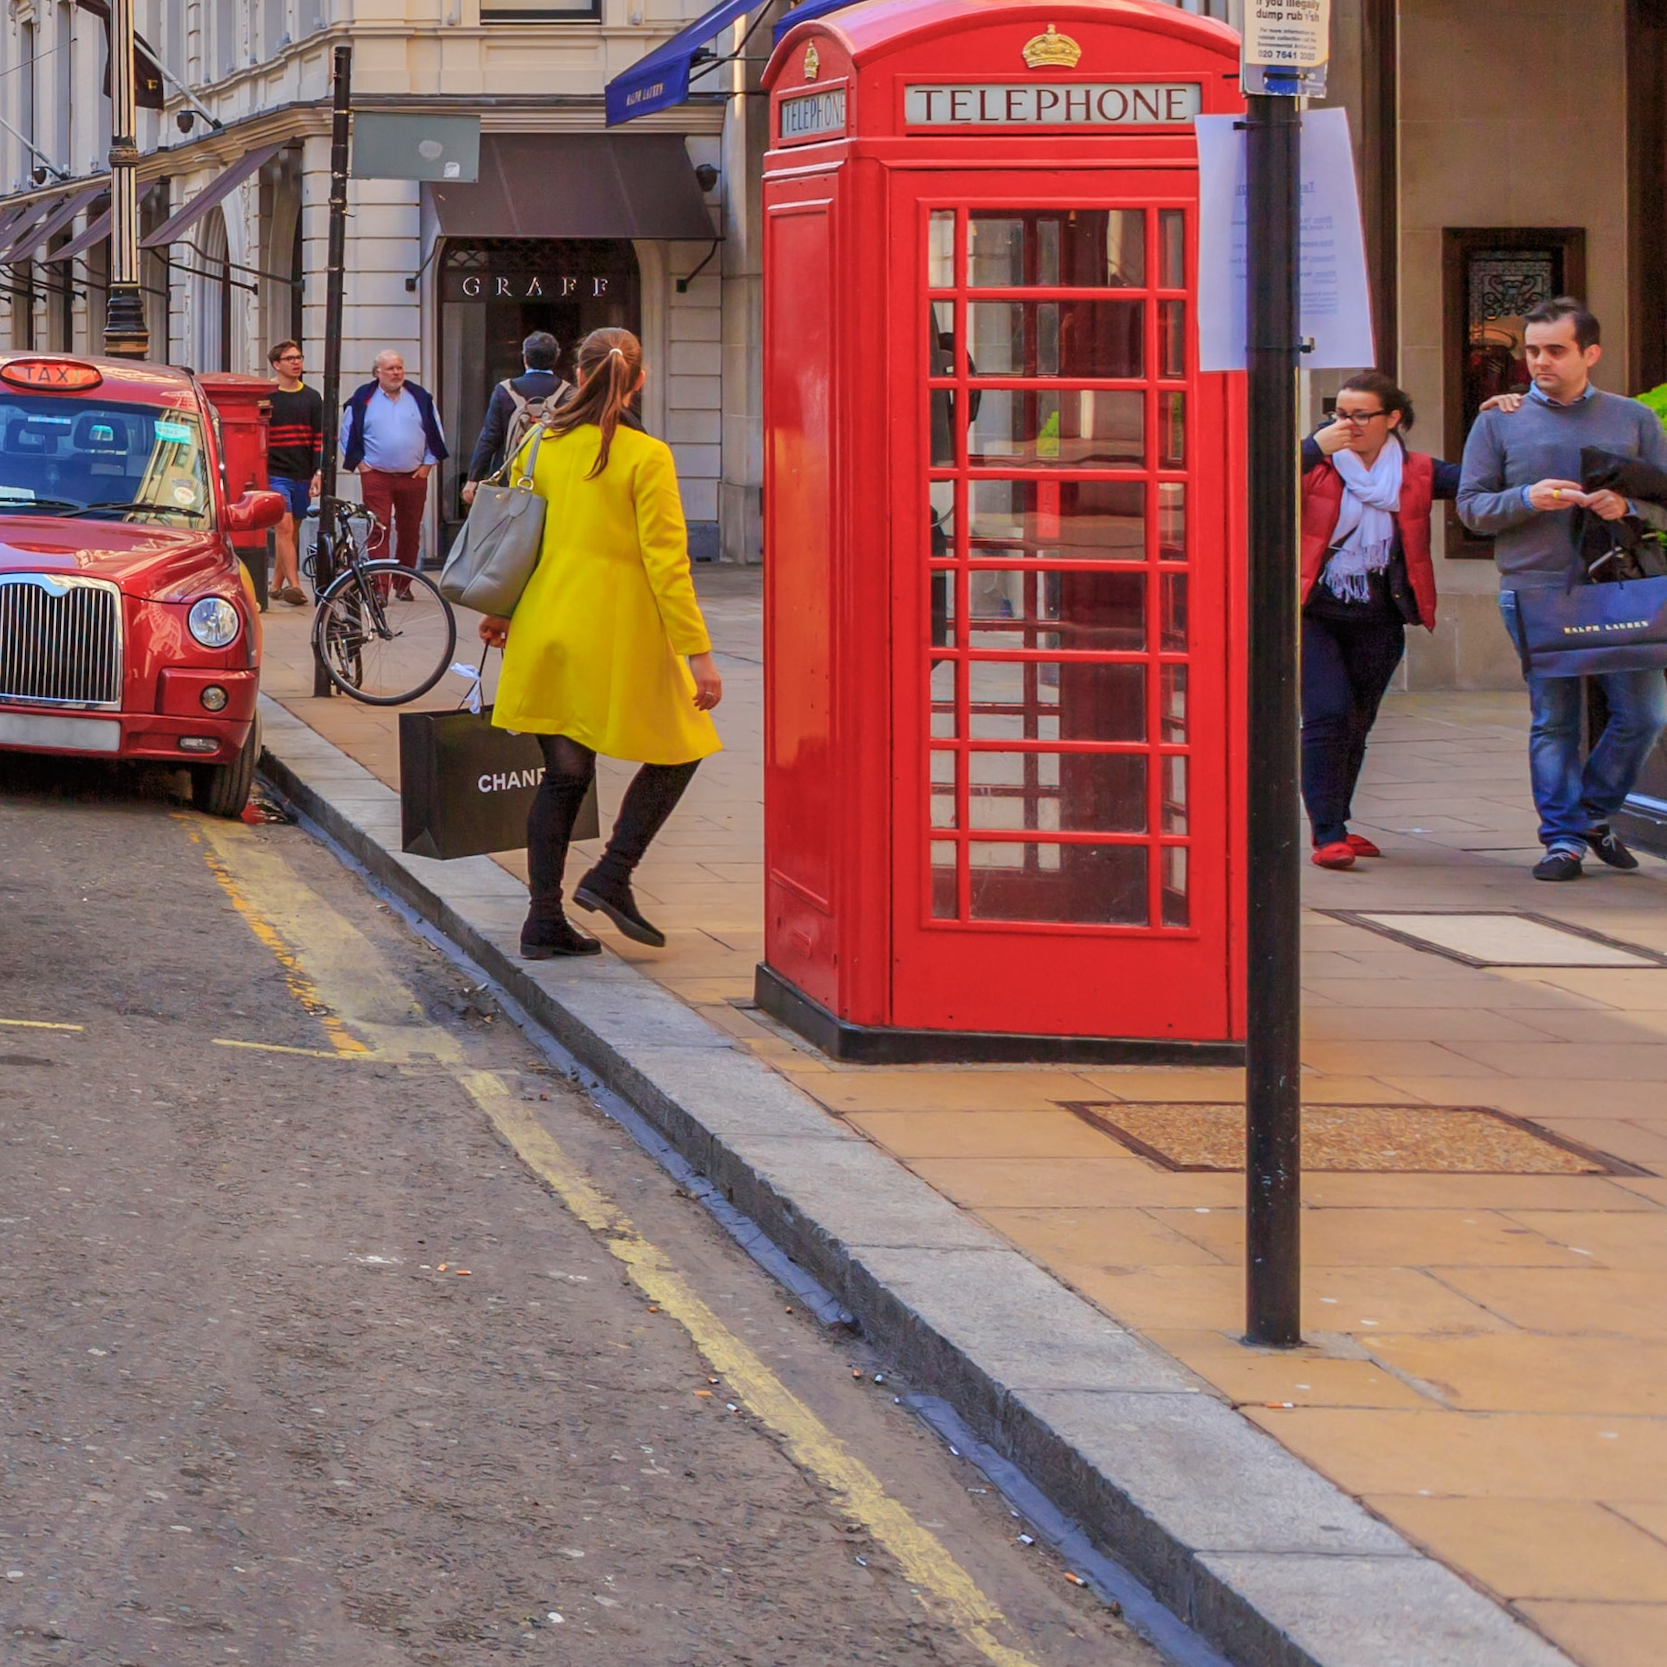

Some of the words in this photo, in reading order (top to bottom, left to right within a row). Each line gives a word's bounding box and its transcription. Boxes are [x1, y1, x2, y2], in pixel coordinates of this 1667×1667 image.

[1256, 9, 1283, 21] dump
[1258, 49, 1273, 58] 020
[1276, 50, 1297, 59] 7641
[784, 90, 846, 133] TELEPHONE
[913, 87, 1189, 123] TELEPHONE
[462, 276, 609, 297] GRAFF
[24, 366, 79, 383] TAXI
[1563, 625, 1600, 635] RALPH
[1605, 620, 1649, 631] LAUREN
[477, 767, 546, 793] CHANE
